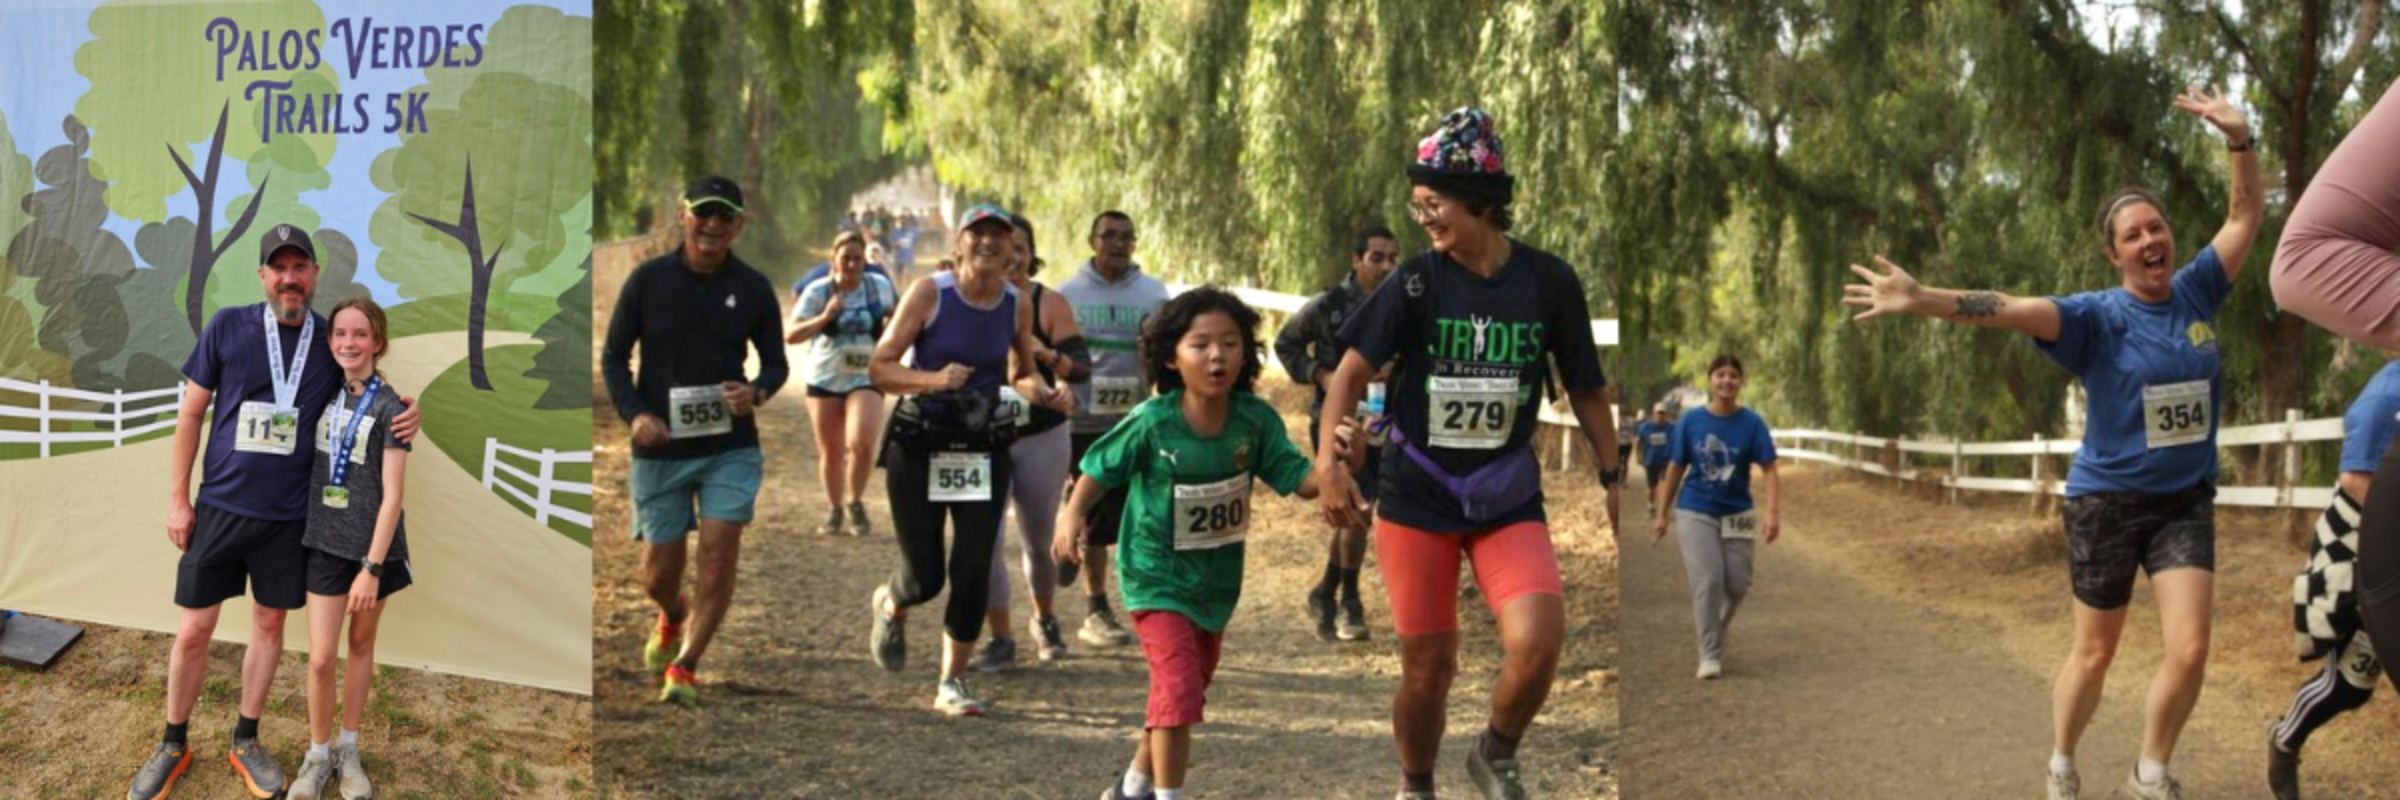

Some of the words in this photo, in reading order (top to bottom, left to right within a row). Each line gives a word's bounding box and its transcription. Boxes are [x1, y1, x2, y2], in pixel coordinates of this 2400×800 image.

[205, 17, 322, 81] PALOS
[330, 17, 484, 80] VERDES
[244, 79, 370, 143] TRAILS
[383, 92, 430, 134] 5K
[1077, 305, 1150, 328] STRIDE
[1428, 318, 1543, 363] TRIDES
[1098, 389, 1131, 405] 272
[680, 401, 723, 425] 553
[1443, 401, 1506, 431] 279
[2158, 401, 2205, 431] 354
[247, 417, 272, 440] 11
[938, 468, 982, 489] 554
[1189, 498, 1243, 533] 280
